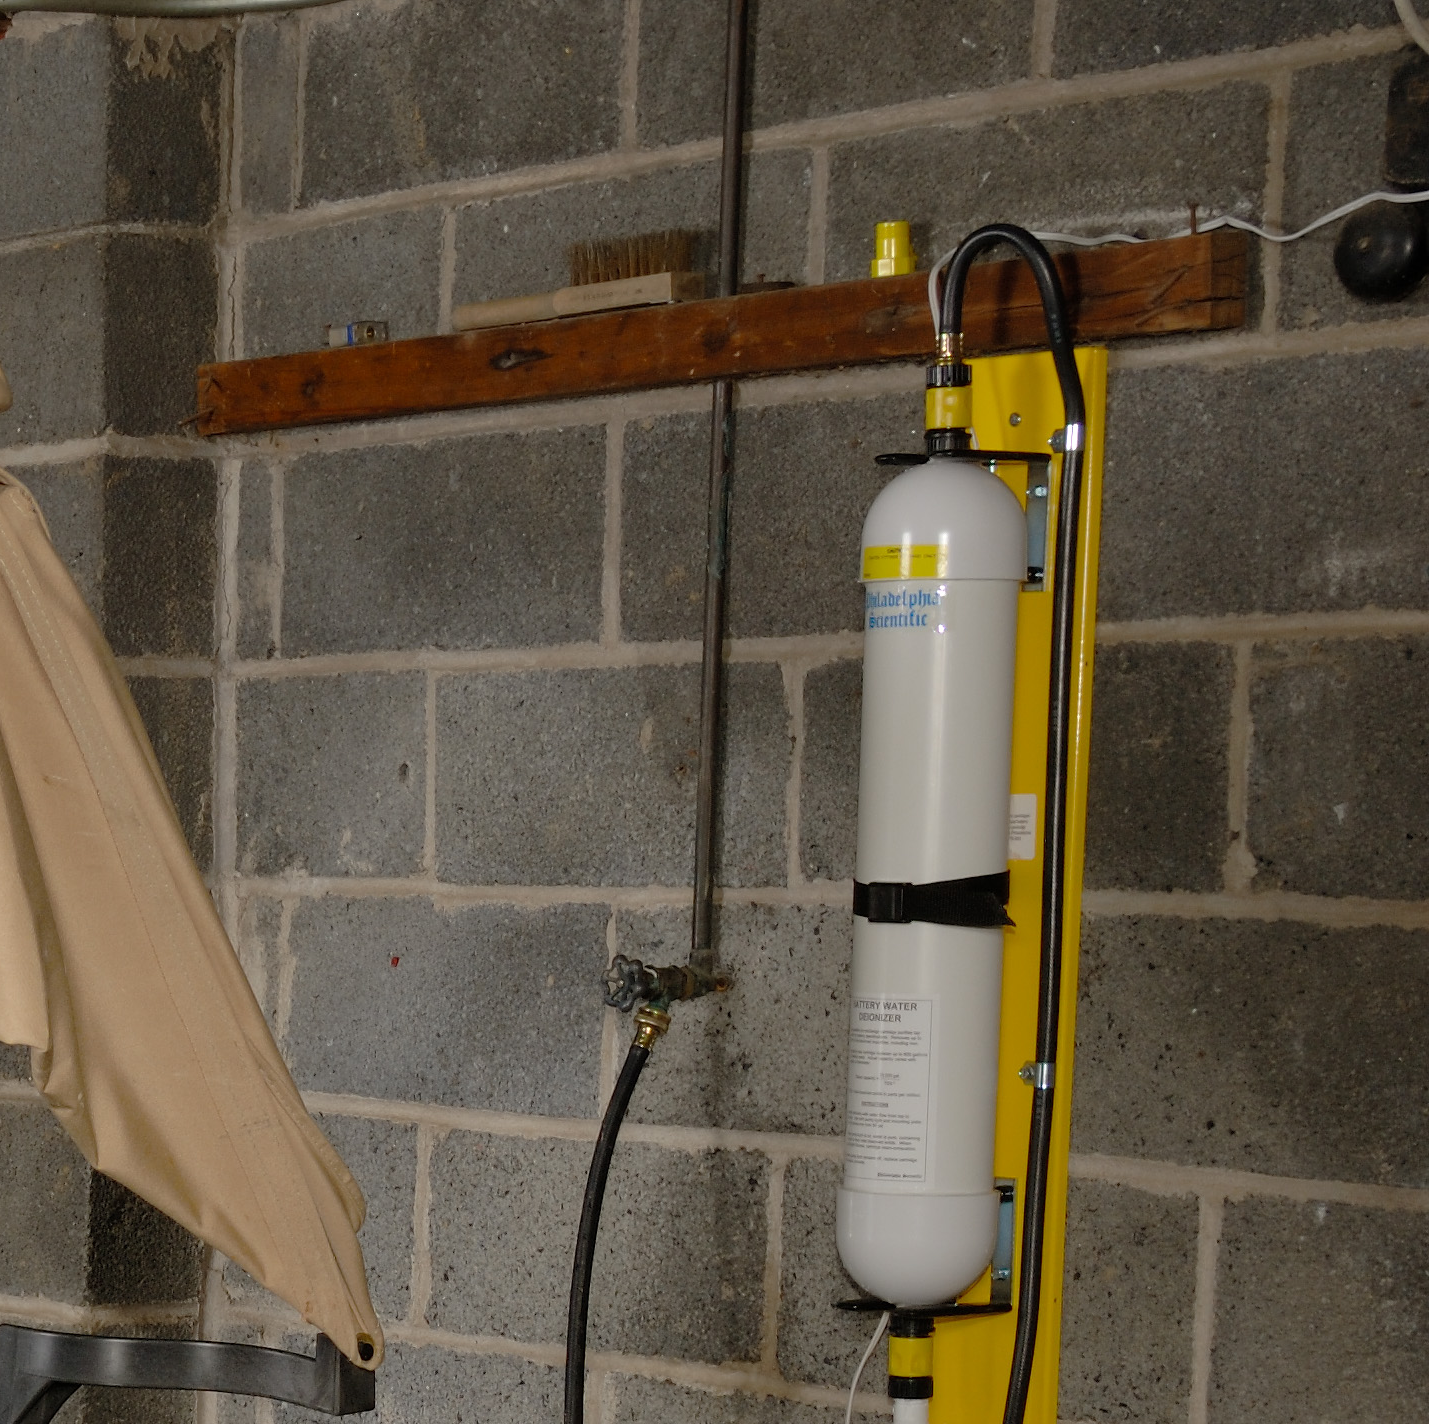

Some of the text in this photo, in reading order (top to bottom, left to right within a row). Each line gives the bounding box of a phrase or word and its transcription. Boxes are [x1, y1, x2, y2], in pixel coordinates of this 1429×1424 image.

[869, 610, 928, 628] Scientific
[883, 1002, 918, 1011] WATER
[858, 1012, 901, 1022] DEIONIZER
